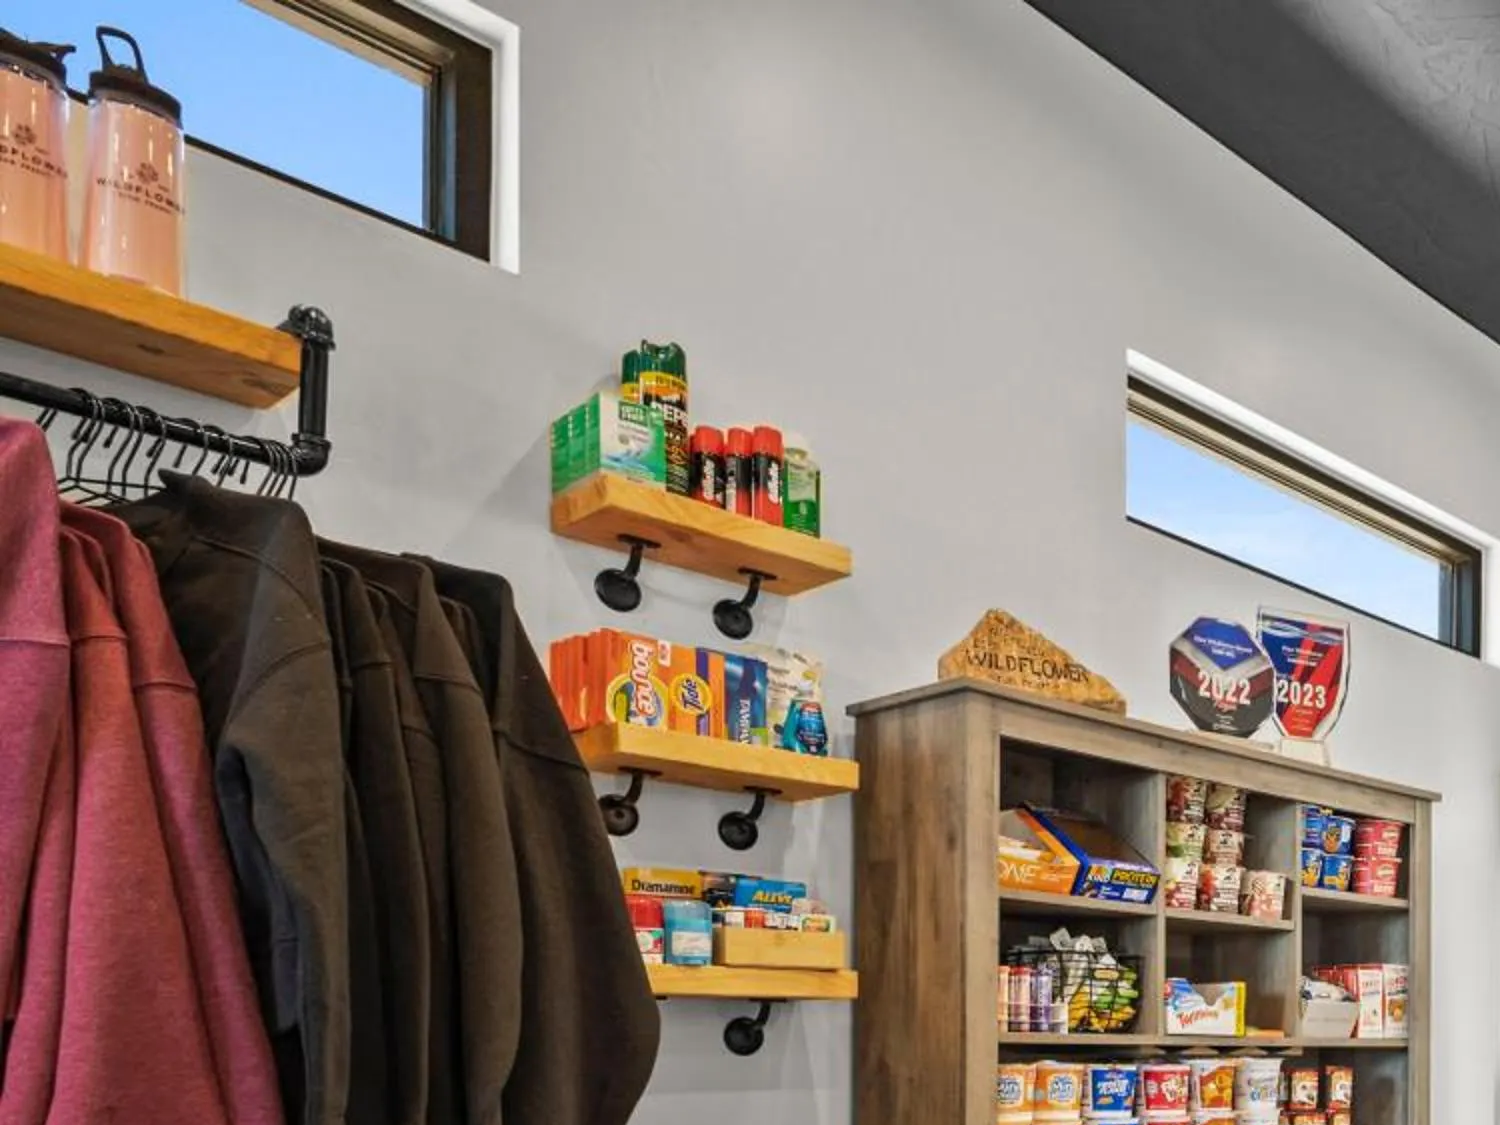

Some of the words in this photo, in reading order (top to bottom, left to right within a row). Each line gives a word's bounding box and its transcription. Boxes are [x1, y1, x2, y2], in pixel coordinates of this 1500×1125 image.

[630, 640, 656, 718] bounce
[965, 650, 1089, 683] WILDFLOWER
[681, 678, 704, 713] Tide
[1197, 671, 1251, 705] 2022
[1276, 679, 1327, 709] 2023
[631, 879, 695, 895] Dramamine
